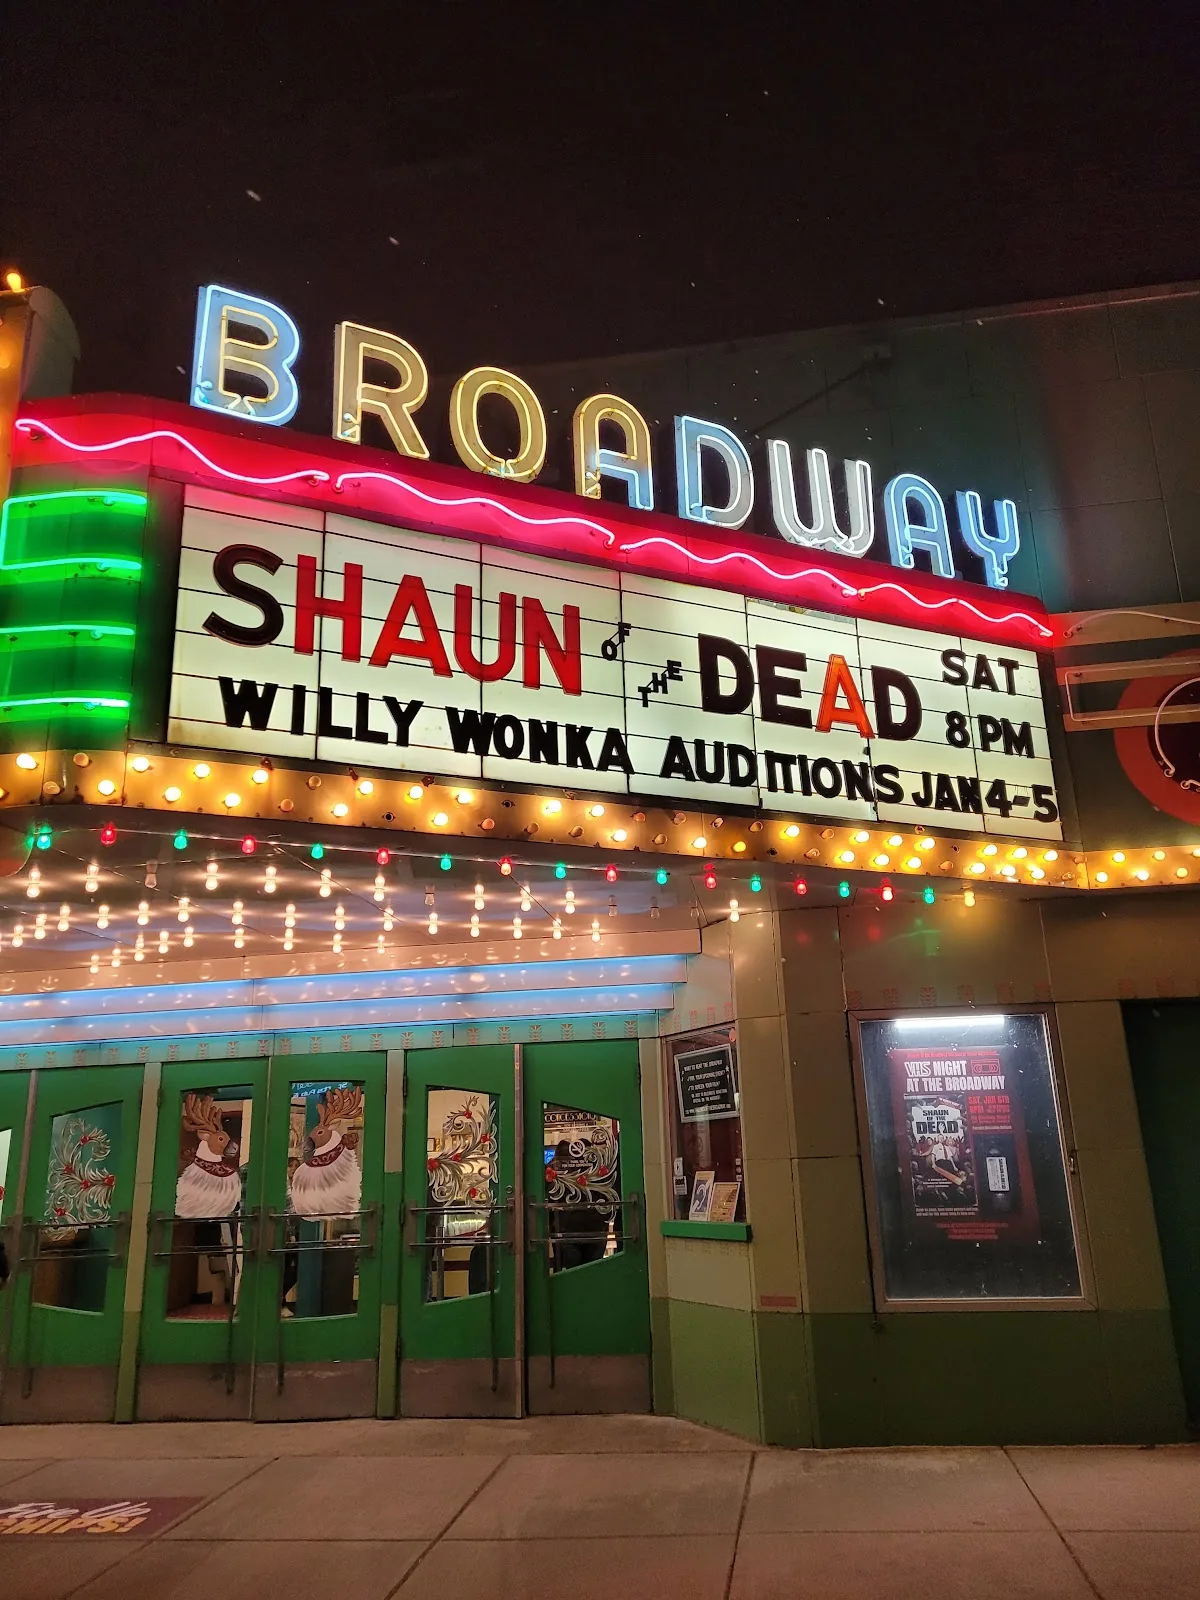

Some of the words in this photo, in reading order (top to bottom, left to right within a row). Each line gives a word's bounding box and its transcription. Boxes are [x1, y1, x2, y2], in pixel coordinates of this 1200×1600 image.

[190, 284, 1020, 588] BROADWAY
[202, 543, 582, 696] SHAUN
[600, 622, 631, 661] OF
[637, 659, 683, 708] THE
[698, 632, 923, 741] DEAD
[941, 648, 1020, 695] SAT
[218, 676, 425, 747] WILLY
[445, 706, 635, 775] WONKA
[659, 735, 904, 804] AUDITIONS
[912, 771, 983, 815] JAN
[985, 778, 1058, 823] 4-5
[904, 1061, 931, 1077] VHS
[932, 1060, 967, 1076] NIGHT
[906, 1077, 920, 1092] AT
[921, 1077, 943, 1091] THE
[945, 1075, 1005, 1091] BROADWAY
[915, 1121, 959, 1134] DEAD
